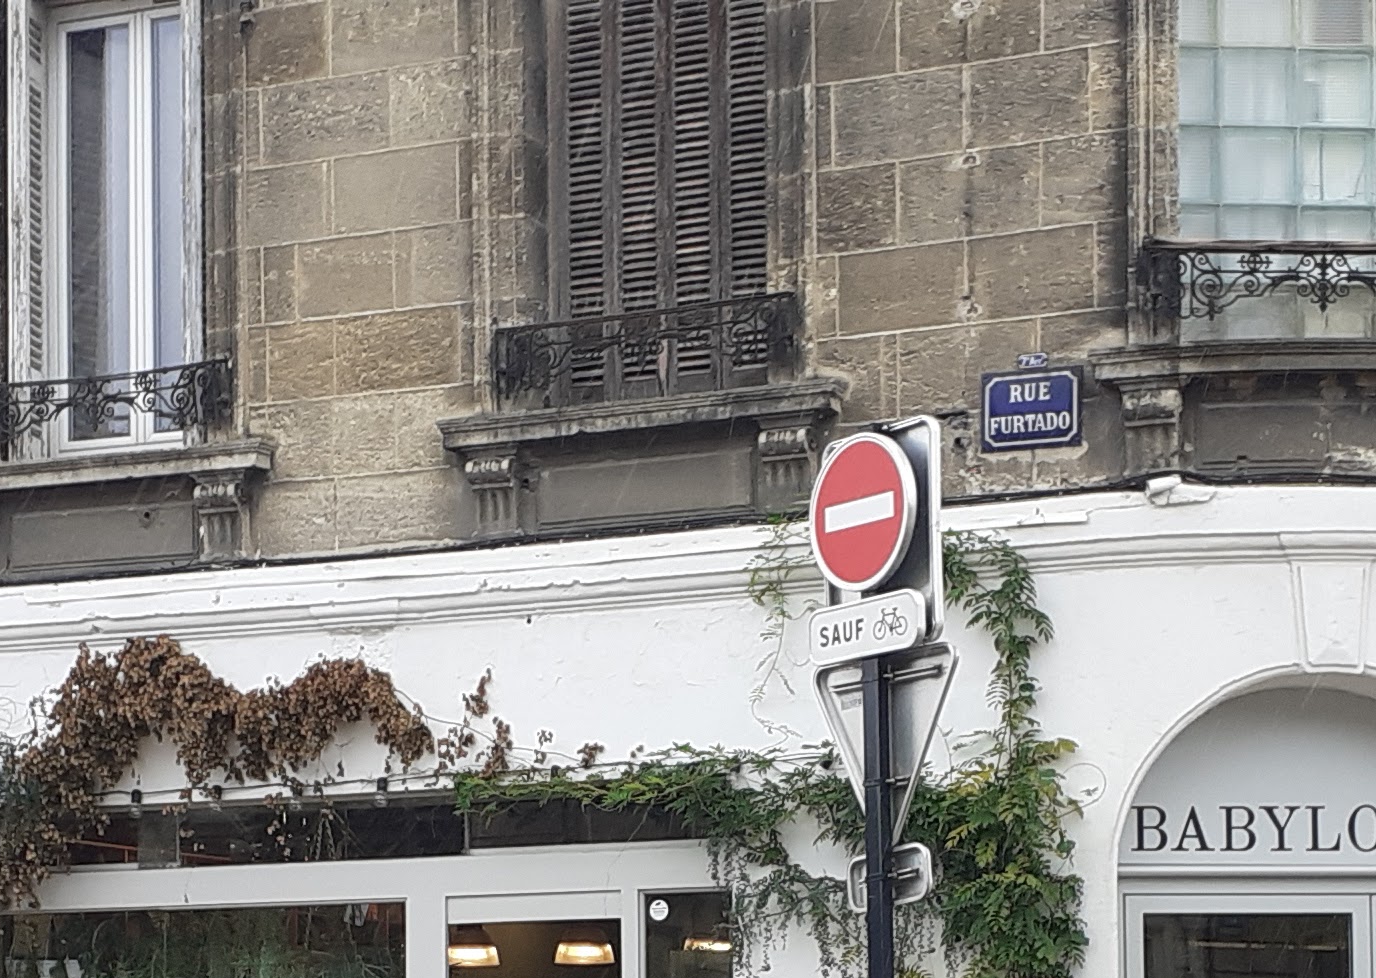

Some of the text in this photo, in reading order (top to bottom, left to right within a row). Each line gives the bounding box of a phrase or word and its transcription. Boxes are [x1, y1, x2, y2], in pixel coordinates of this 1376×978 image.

[1009, 381, 1051, 404] RUE
[990, 411, 1071, 436] FURTADO
[819, 617, 865, 648] SAUF
